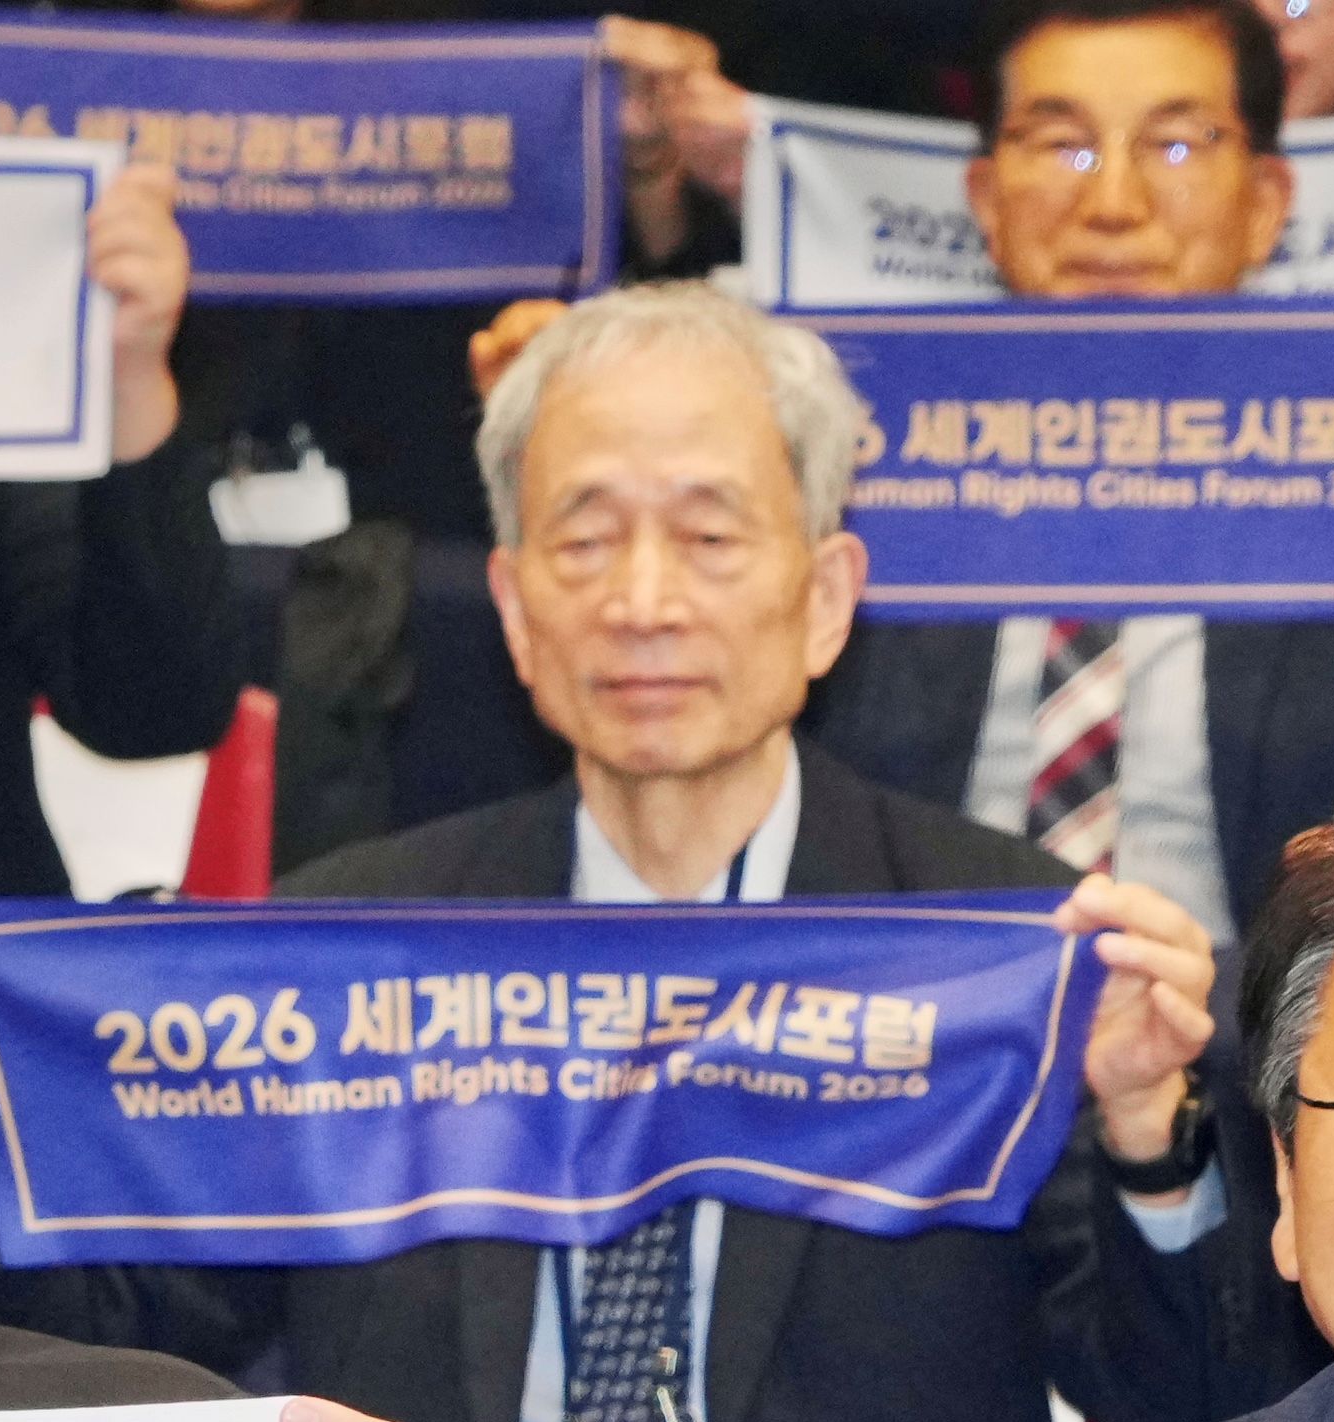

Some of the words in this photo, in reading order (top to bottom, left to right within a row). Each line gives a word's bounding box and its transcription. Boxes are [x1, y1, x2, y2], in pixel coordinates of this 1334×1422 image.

[867, 195, 991, 254] 202
[850, 476, 956, 509] uman
[960, 469, 1083, 519] Rights
[1086, 469, 1197, 510] Cities
[1200, 469, 1323, 509] Forum
[94, 987, 317, 1075] 2026
[339, 970, 939, 1070] 세계인권도시포럼
[112, 1079, 245, 1120] World
[250, 1074, 404, 1117] Human
[410, 1055, 550, 1106] Rights
[666, 1050, 810, 1099] Forum
[817, 1070, 931, 1102] 2026
